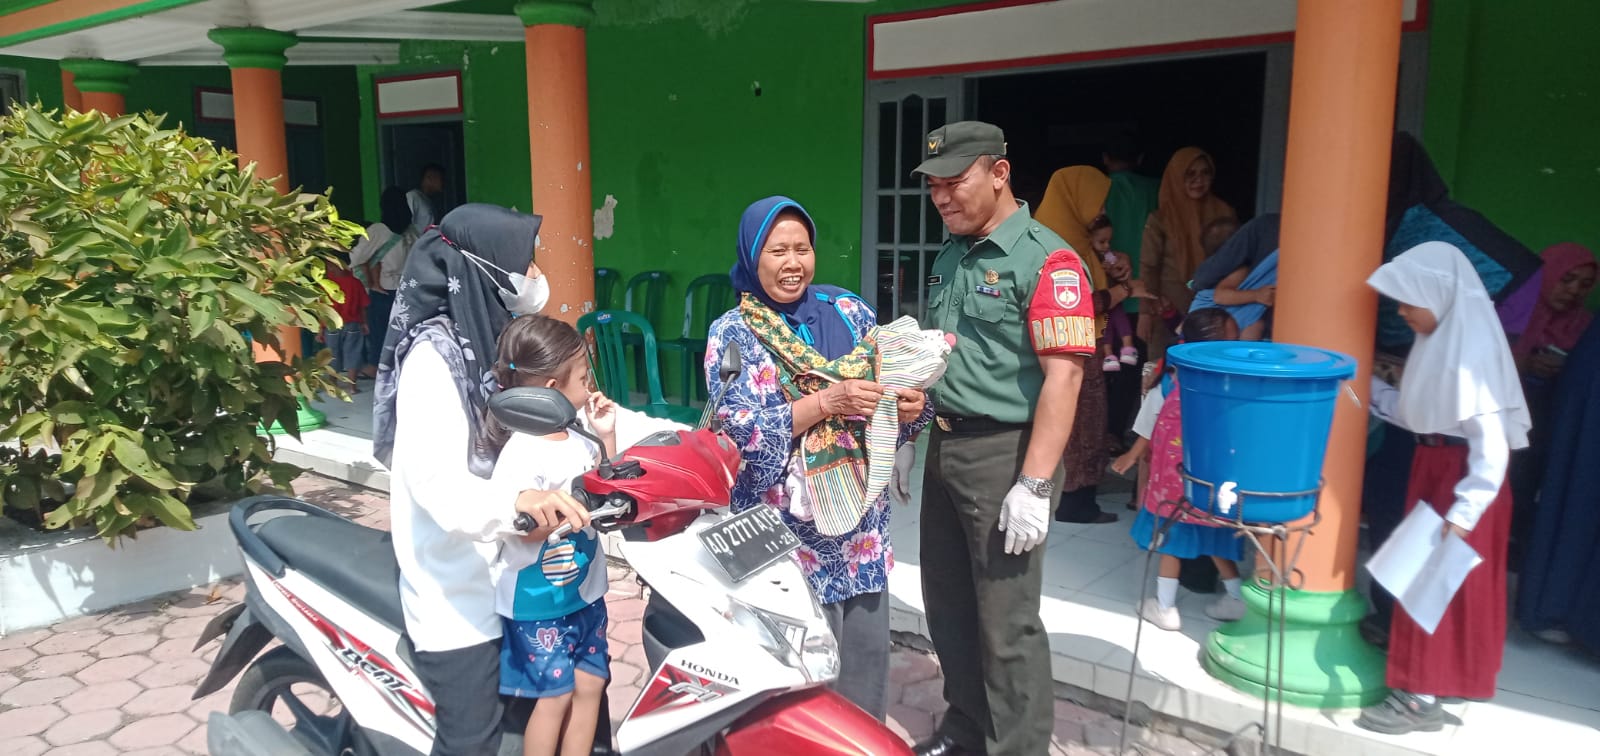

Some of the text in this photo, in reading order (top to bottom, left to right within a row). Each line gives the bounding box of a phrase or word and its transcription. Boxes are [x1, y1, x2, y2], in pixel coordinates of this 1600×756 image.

[705, 508, 780, 554] AD 2777 AYE
[681, 659, 740, 685] HONDA
